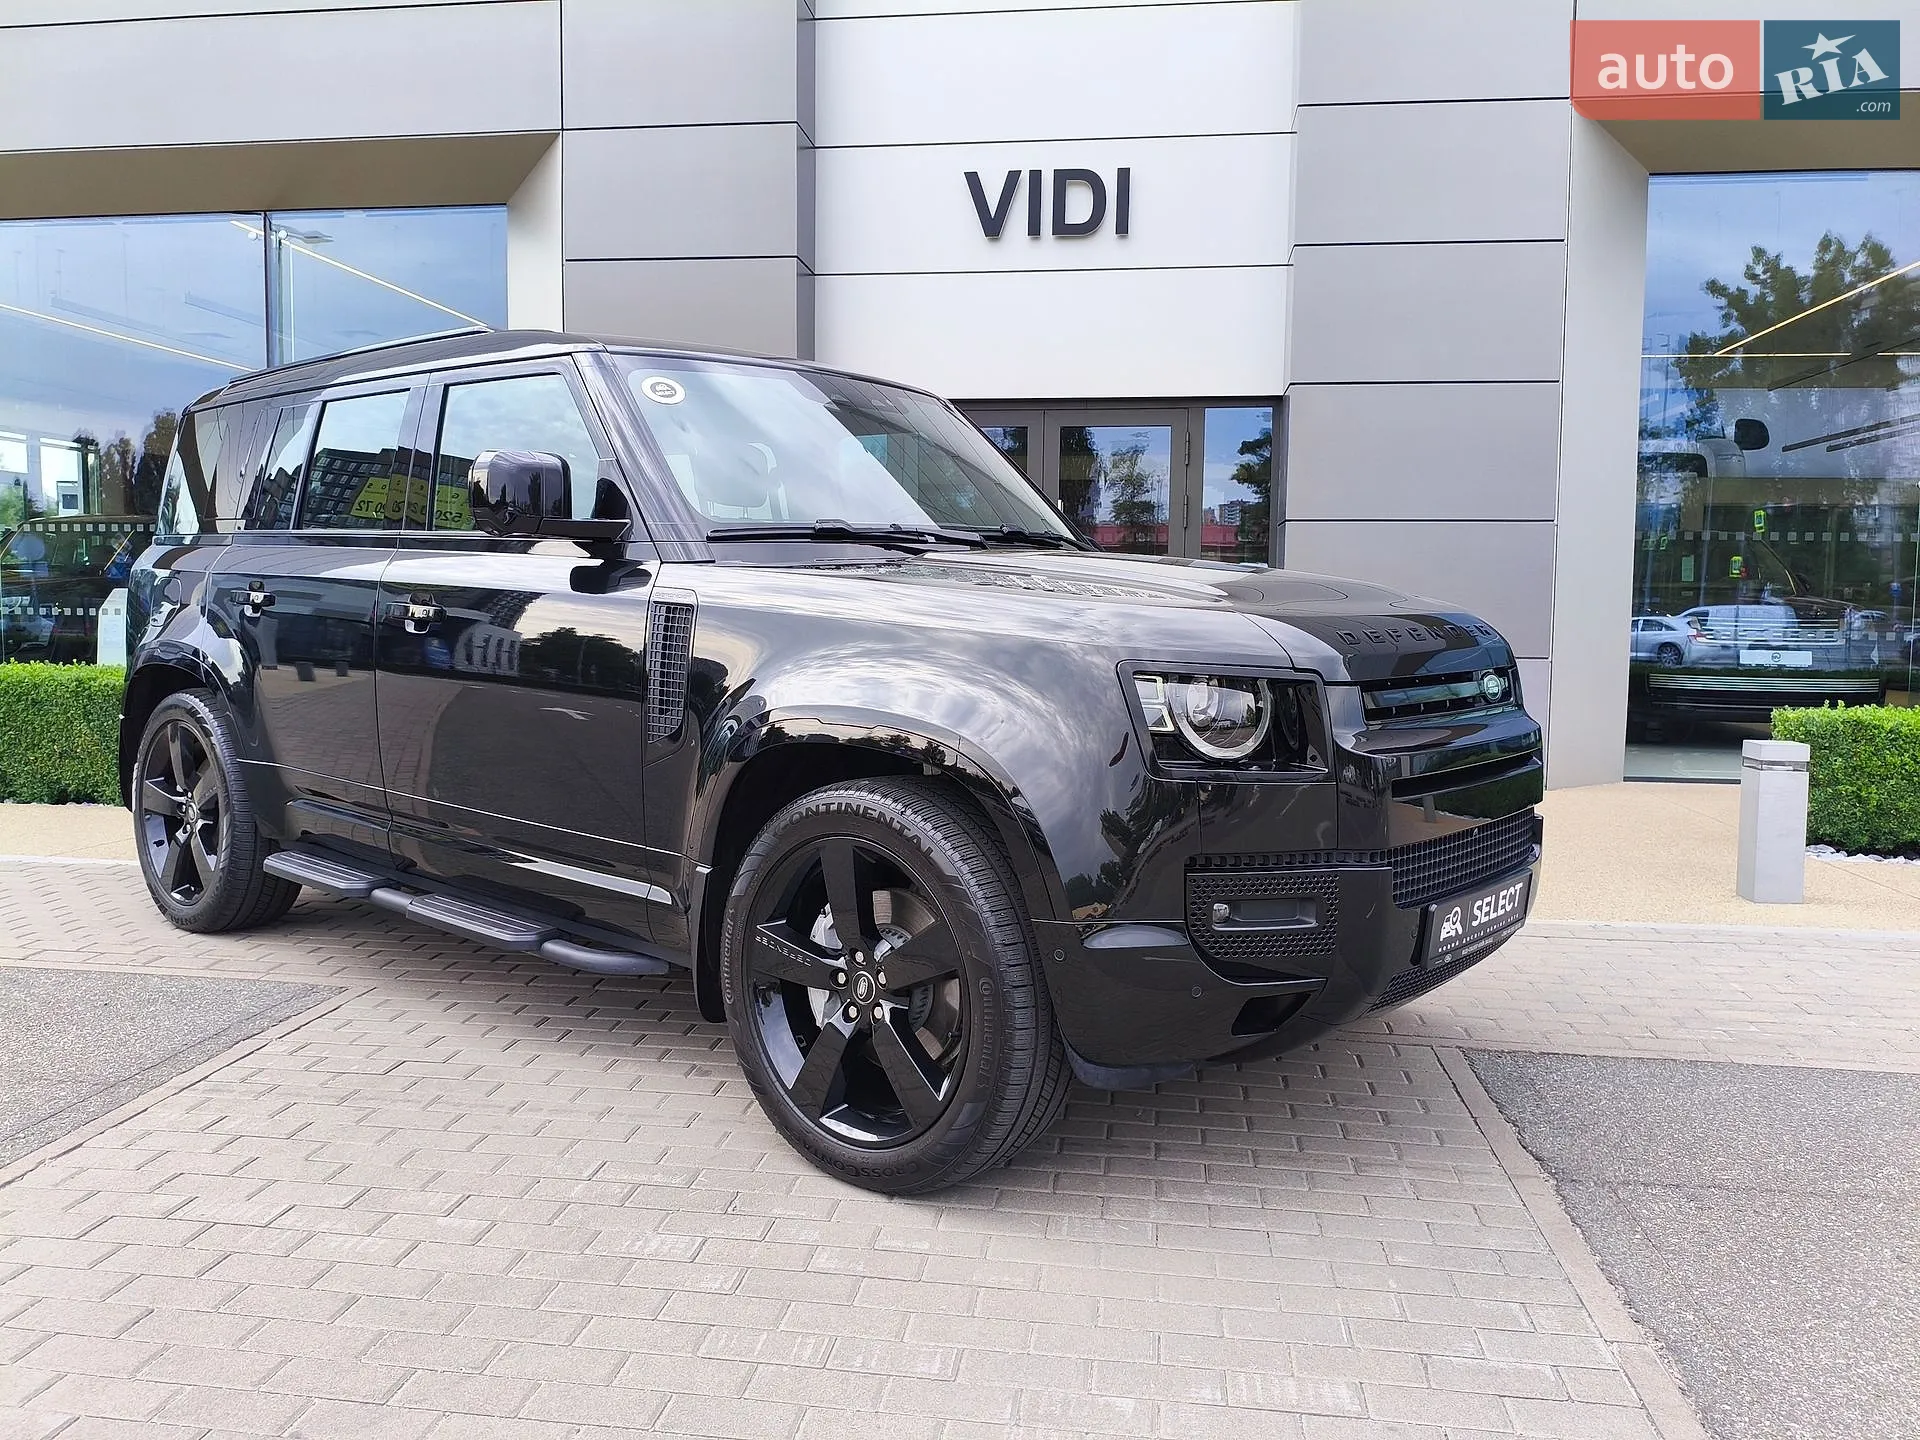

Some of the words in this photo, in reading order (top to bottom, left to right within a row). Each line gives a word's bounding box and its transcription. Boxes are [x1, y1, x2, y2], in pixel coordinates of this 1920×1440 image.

[963, 167, 1131, 238] VIDI
[1336, 623, 1493, 646] DEFENDER
[776, 801, 934, 857] CONTINENTAL
[1471, 882, 1523, 927] SELECT
